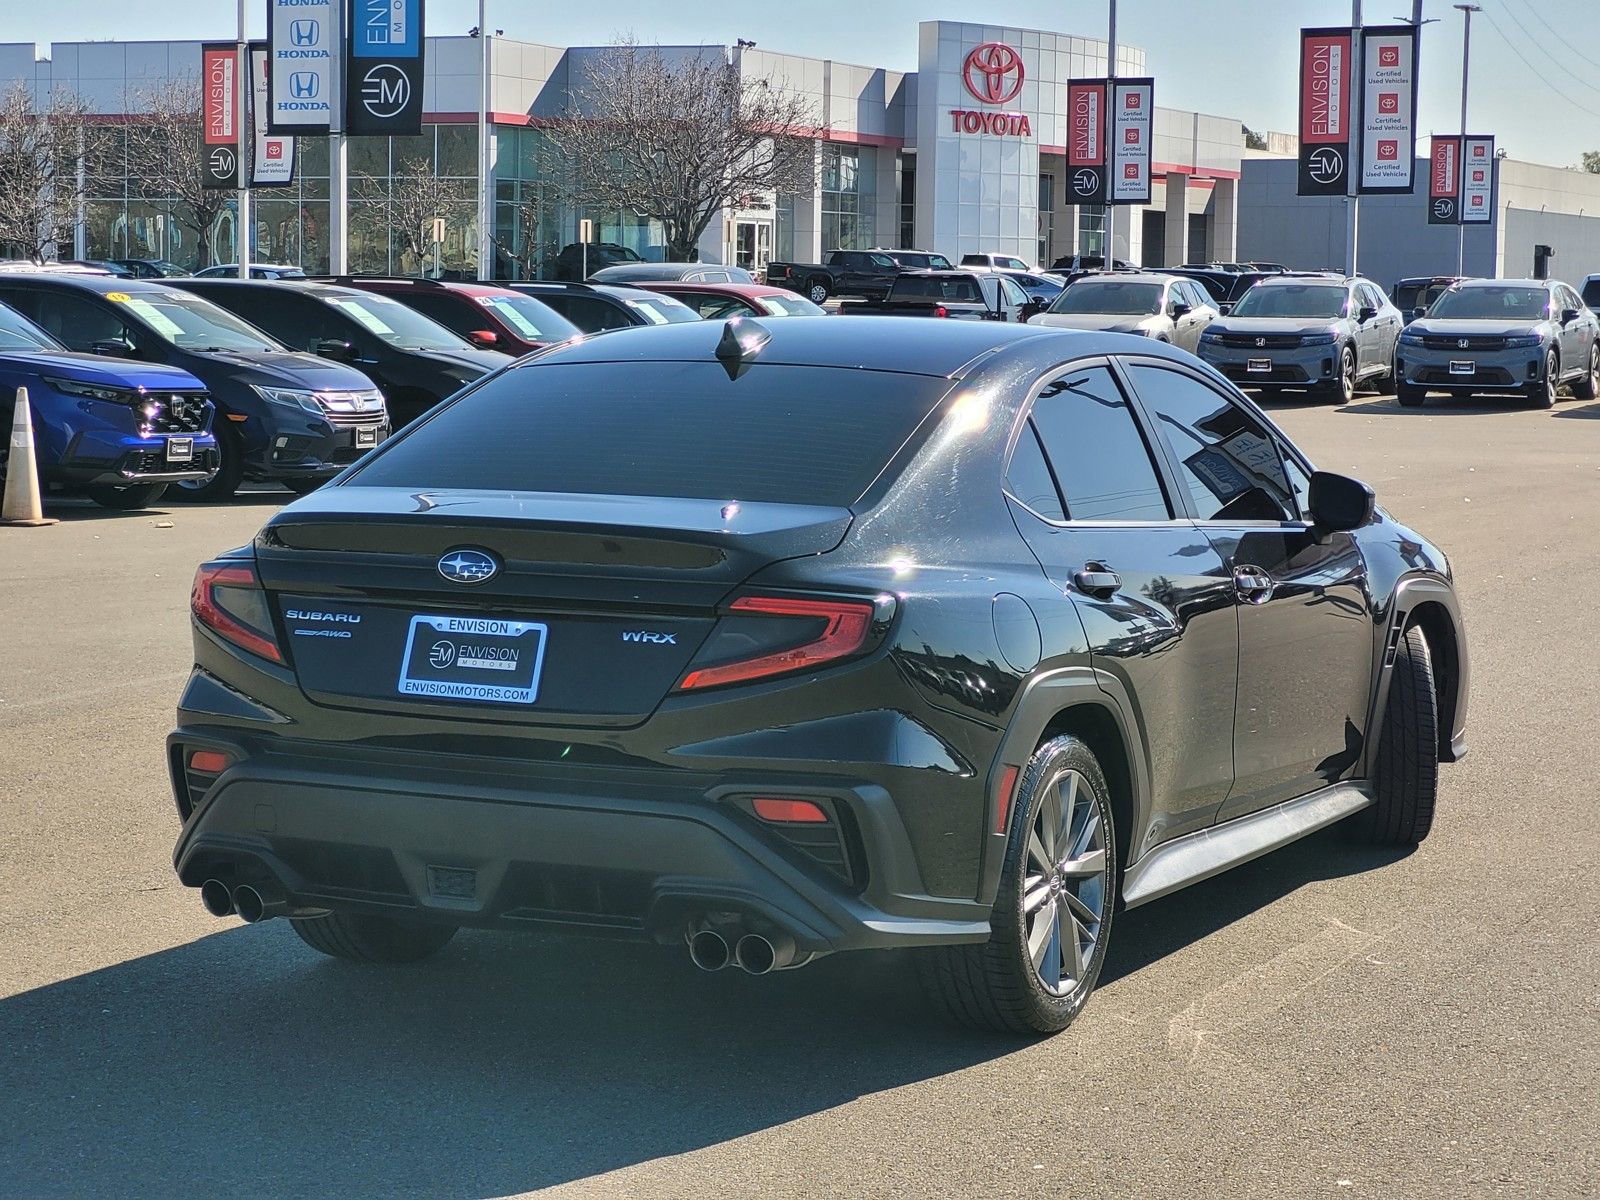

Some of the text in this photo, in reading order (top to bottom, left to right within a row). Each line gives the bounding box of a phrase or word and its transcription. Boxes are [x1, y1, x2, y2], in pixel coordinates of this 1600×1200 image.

[278, 50, 330, 58] HONDA
[212, 58, 224, 136] ENVISION
[1312, 45, 1329, 135] ENVISION
[1331, 53, 1339, 126] MOTORS
[278, 102, 330, 110] HONDA
[950, 110, 1032, 136] TOYOTA
[1076, 92, 1088, 160] ENVISION
[1437, 144, 1446, 192] ENVISION
[286, 610, 360, 623] SUBARU
[449, 619, 508, 634] ENVISION
[622, 630, 678, 644] WRX
[458, 645, 520, 661] ENVISION
[462, 660, 512, 669] MOTORS
[404, 681, 529, 700] ENVISIONMOTORS.COM
